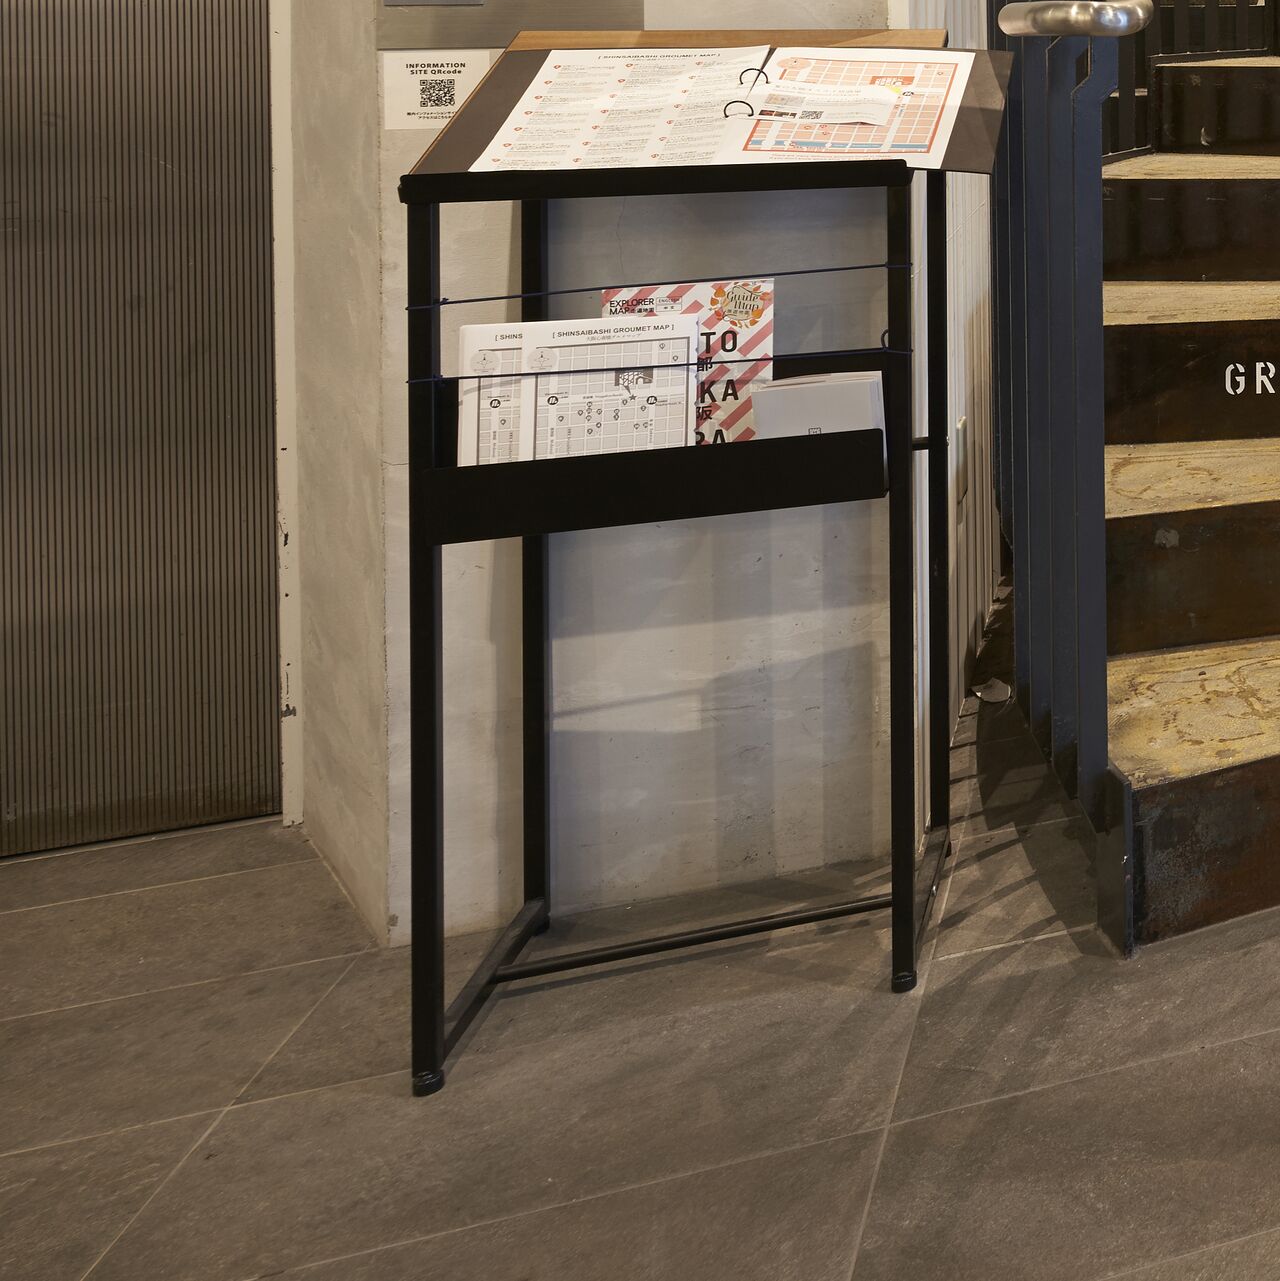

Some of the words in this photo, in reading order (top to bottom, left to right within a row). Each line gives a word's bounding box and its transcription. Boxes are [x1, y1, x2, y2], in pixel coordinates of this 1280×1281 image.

[609, 297, 655, 308] EXPLORER
[609, 306, 630, 315] MAP
[557, 328, 611, 338] SHINSAIBASHI
[613, 326, 651, 334] GROUMET
[700, 330, 738, 354] TO
[700, 379, 739, 404] KA
[696, 405, 713, 420] 阪
